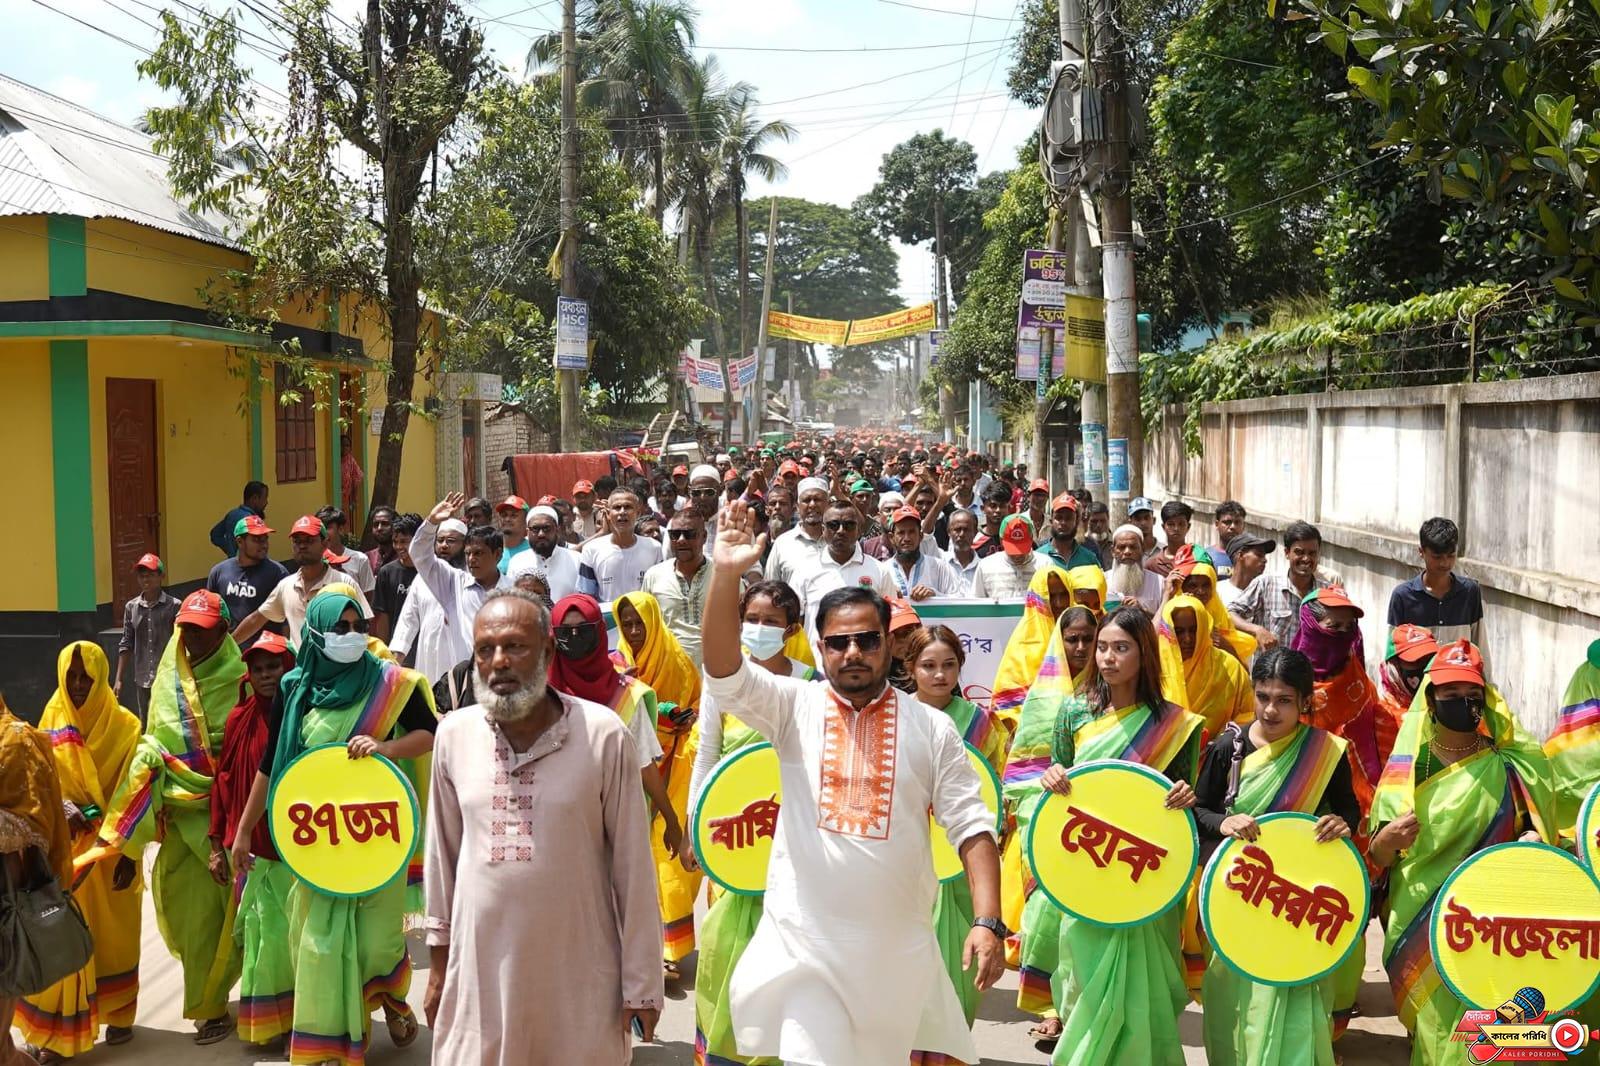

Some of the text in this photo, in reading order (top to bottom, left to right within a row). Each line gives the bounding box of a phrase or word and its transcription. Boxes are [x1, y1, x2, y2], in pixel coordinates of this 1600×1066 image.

[1029, 255, 1055, 270] ঢাবি
[562, 314, 585, 326] HSC
[226, 581, 257, 598] MAD
[288, 801, 401, 846] ৪৭তম
[708, 793, 781, 850] বার্ষি
[1060, 806, 1169, 884] হোক
